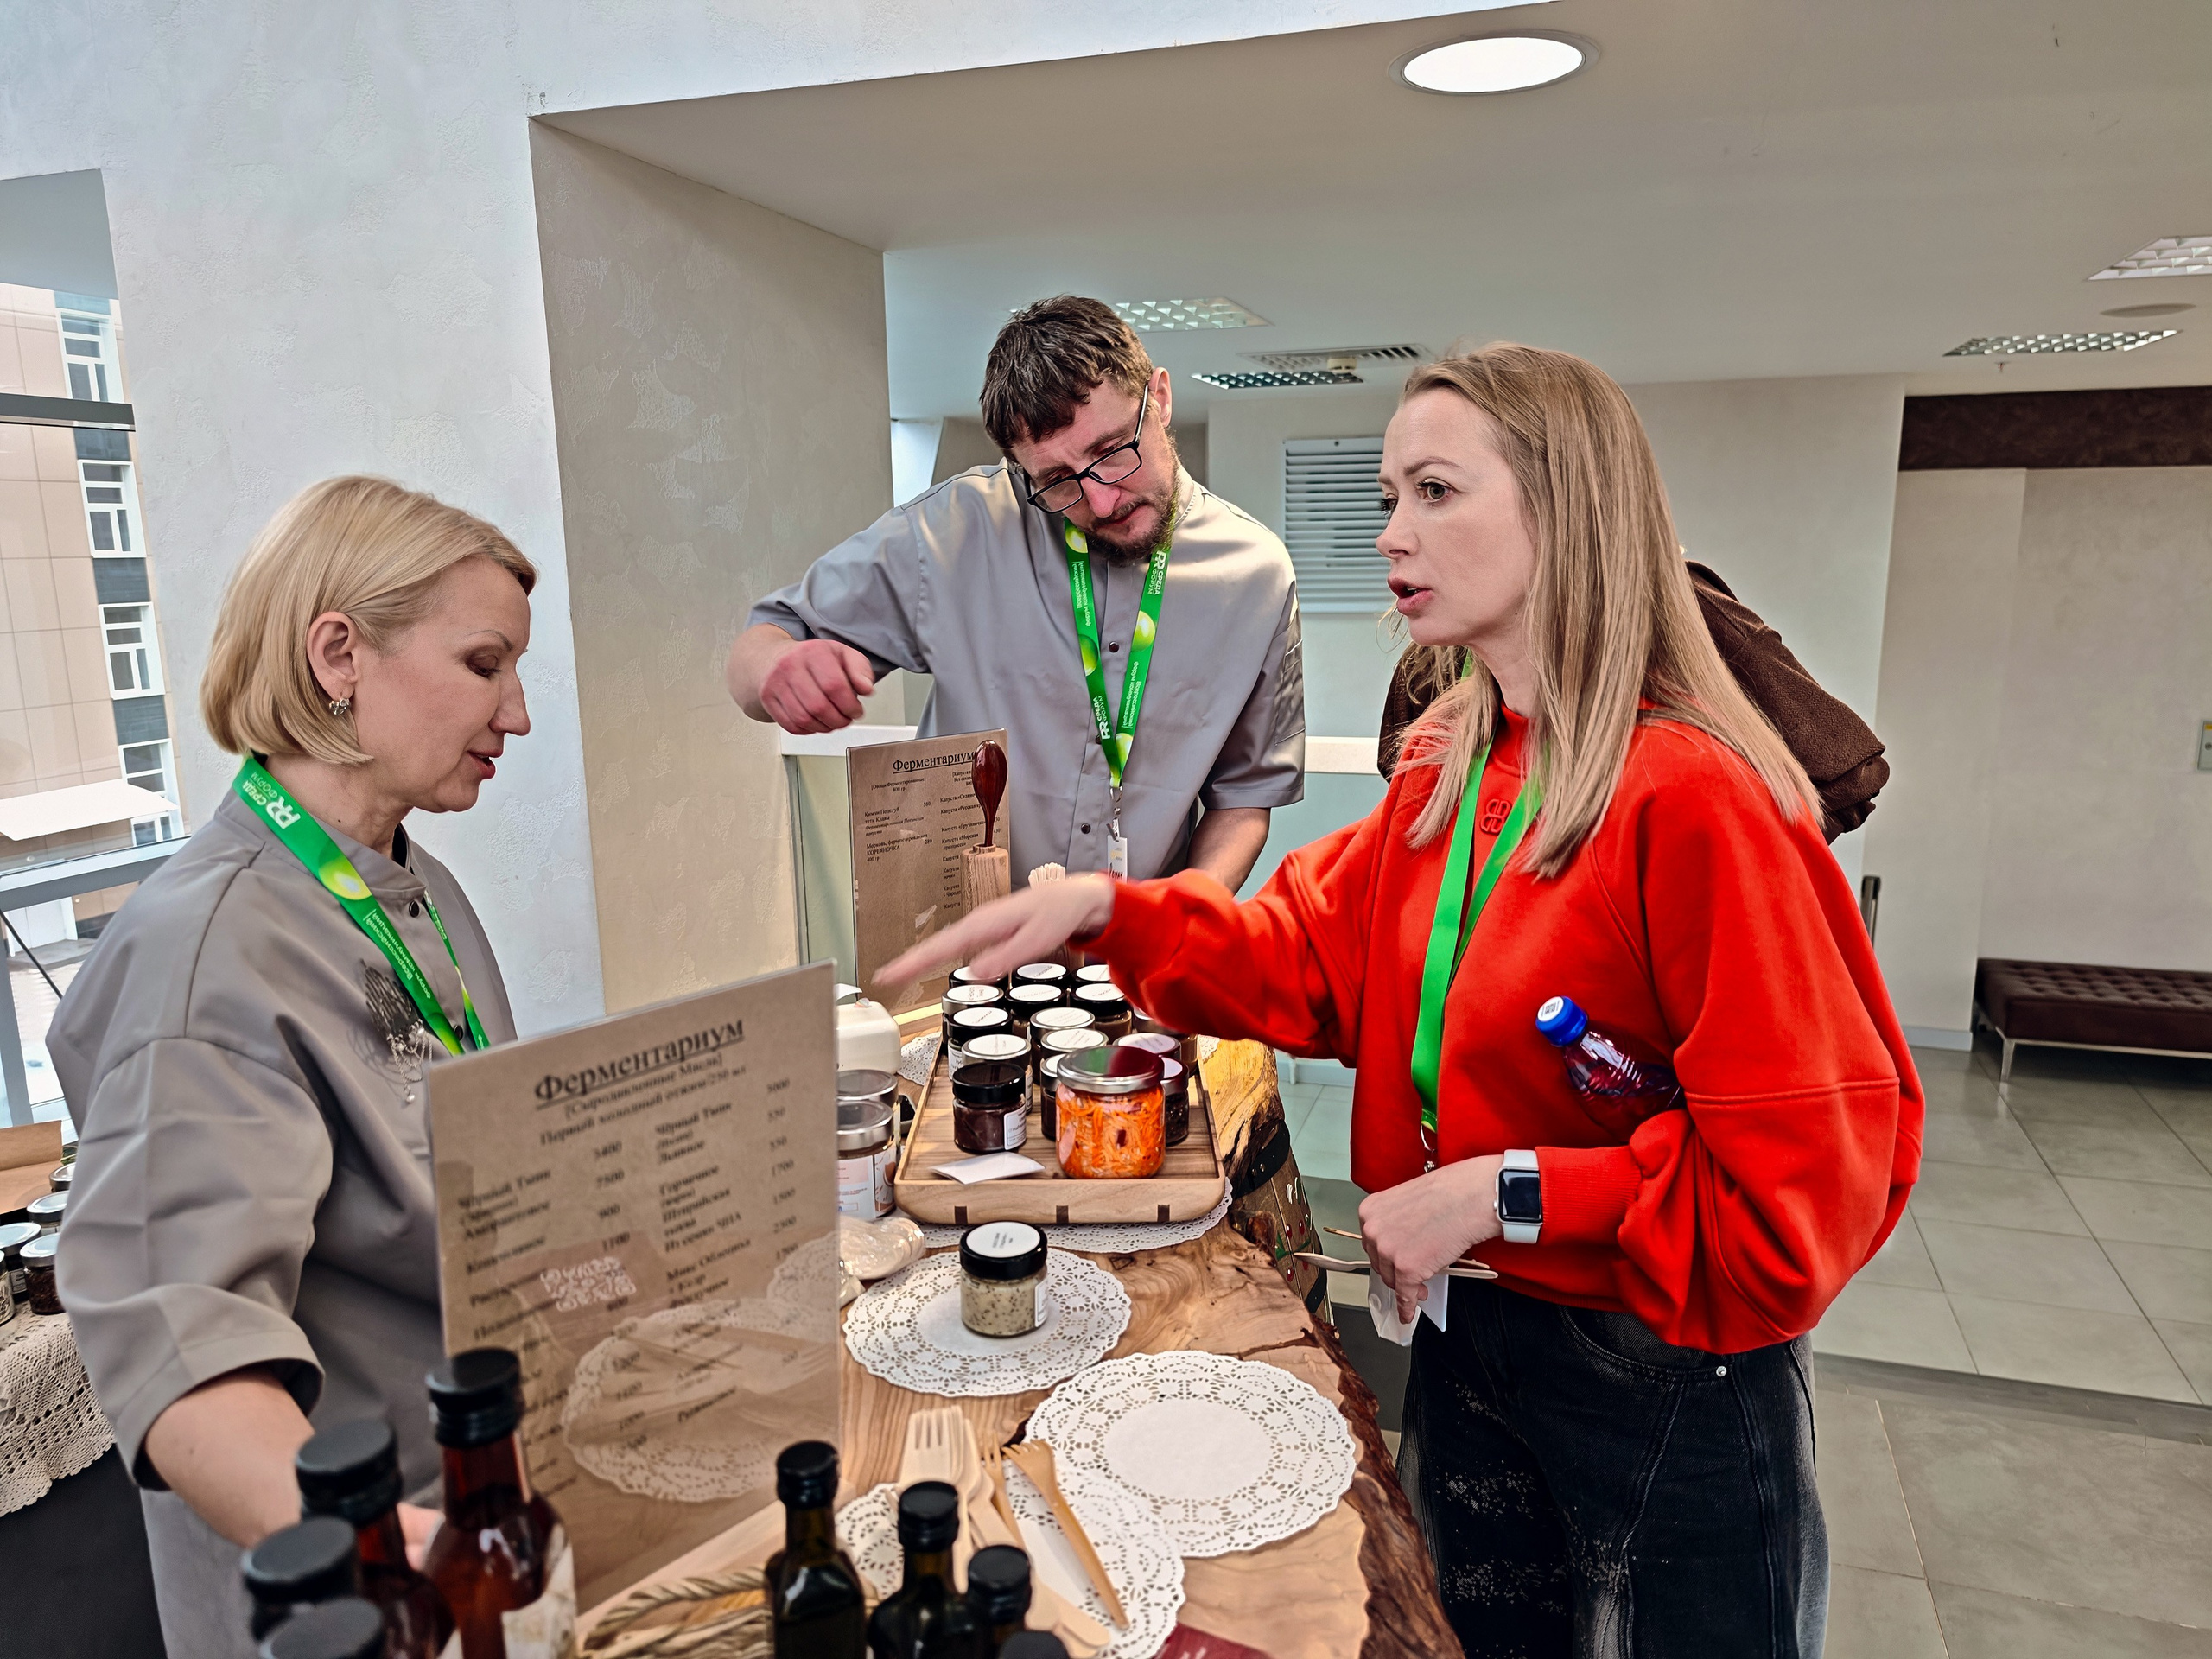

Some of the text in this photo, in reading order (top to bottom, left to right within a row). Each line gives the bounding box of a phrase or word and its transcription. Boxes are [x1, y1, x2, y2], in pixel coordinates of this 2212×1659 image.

[1147, 569, 1157, 594] ФОРУМ
[1154, 570, 1164, 595] СРЕДА
[1092, 696, 1102, 721] СРЕДА
[1097, 695, 1107, 721] ФОРУМ
[893, 751, 976, 772] Ферментариум
[242, 779, 267, 806] СРЕДА
[251, 772, 278, 798] ФОРУМ
[266, 795, 301, 830] PR
[365, 918, 413, 981] Всероссийский
[372, 912, 431, 999] форум коммуникаций
[534, 1019, 744, 1100] Ферментариум
[539, 1117, 595, 1147] Первый
